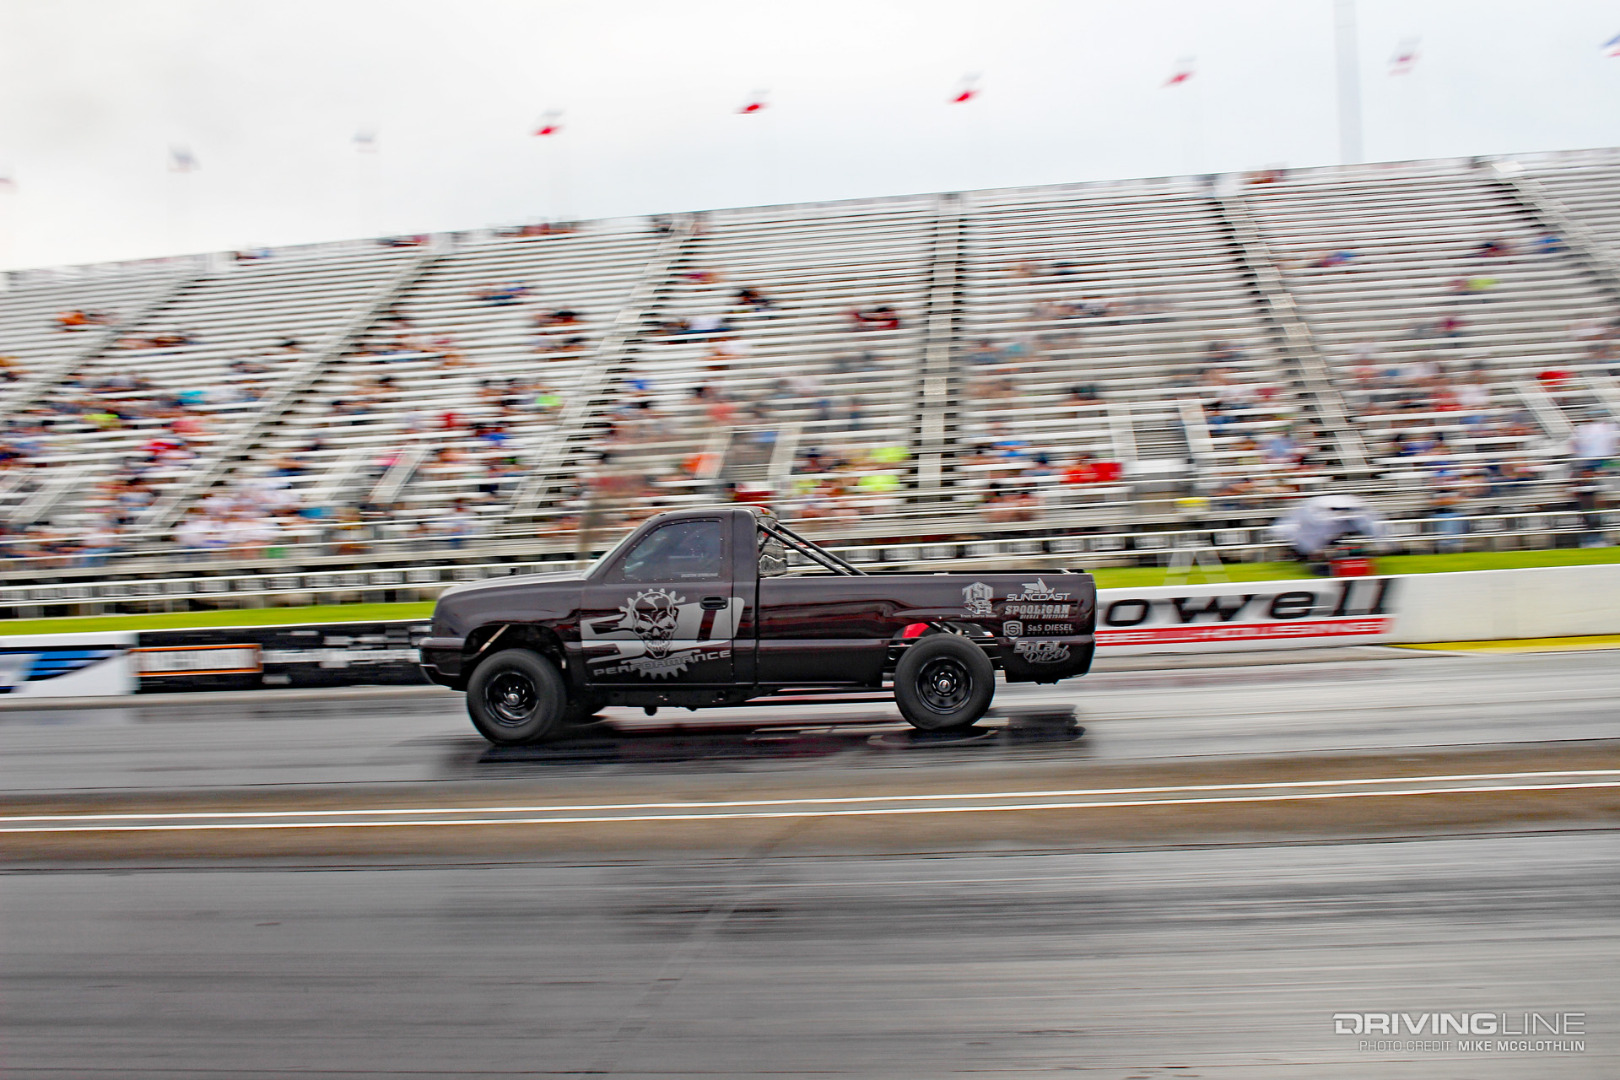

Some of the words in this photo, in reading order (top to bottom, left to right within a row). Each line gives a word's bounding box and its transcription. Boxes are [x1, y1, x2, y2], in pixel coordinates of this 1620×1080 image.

[962, 582, 993, 603] TSD
[1006, 593, 1071, 602] SUNCOAST
[1104, 578, 1396, 626] owell
[1027, 624, 1042, 632] S&S
[1044, 623, 1073, 631] DIESEL
[1024, 644, 1070, 663] Diesel
